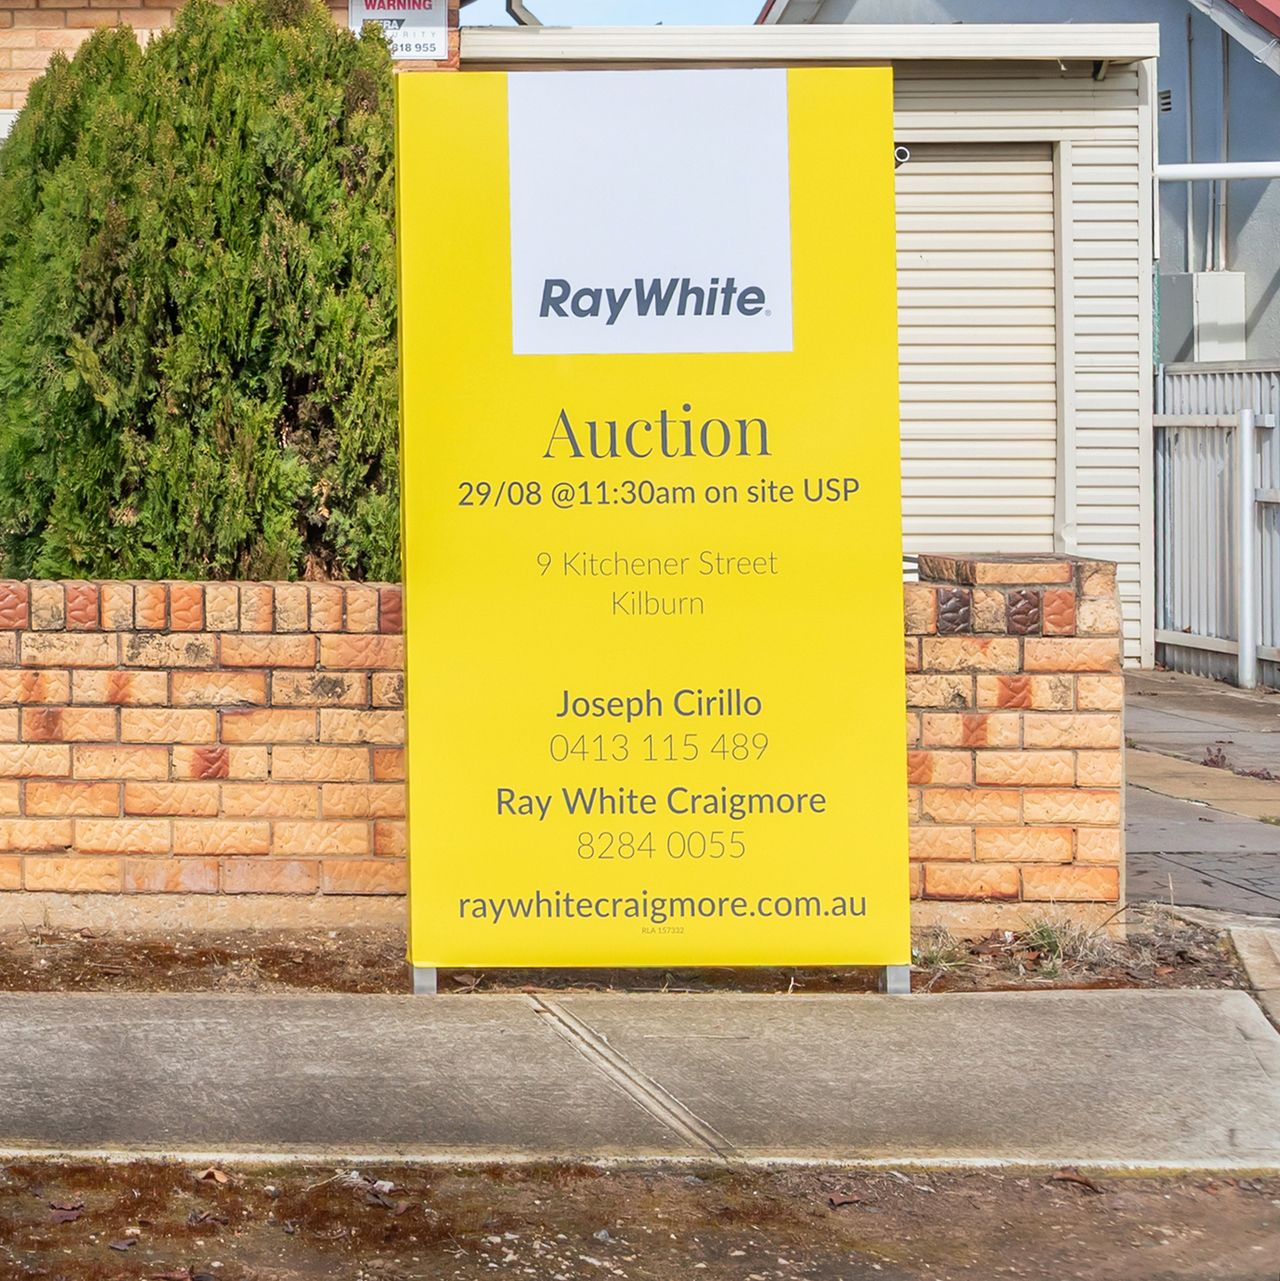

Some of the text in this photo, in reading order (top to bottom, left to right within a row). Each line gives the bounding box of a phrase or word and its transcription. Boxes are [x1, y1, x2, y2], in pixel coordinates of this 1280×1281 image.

[415, 43, 436, 52] 955
[542, 402, 773, 460] Auction
[458, 477, 860, 510] 29/08 @11:30am on site USP
[536, 550, 779, 577] 9 Kitchener Street
[612, 590, 704, 616] Kilburn
[555, 687, 762, 724] Joseph Cirillo
[549, 733, 769, 762] 0413 115 489
[496, 785, 827, 822] Ray White Craigmore
[577, 830, 746, 860] 8284 0055
[459, 889, 866, 925] raywhitecraigmore.com.au
[641, 926, 656, 935] RLA
